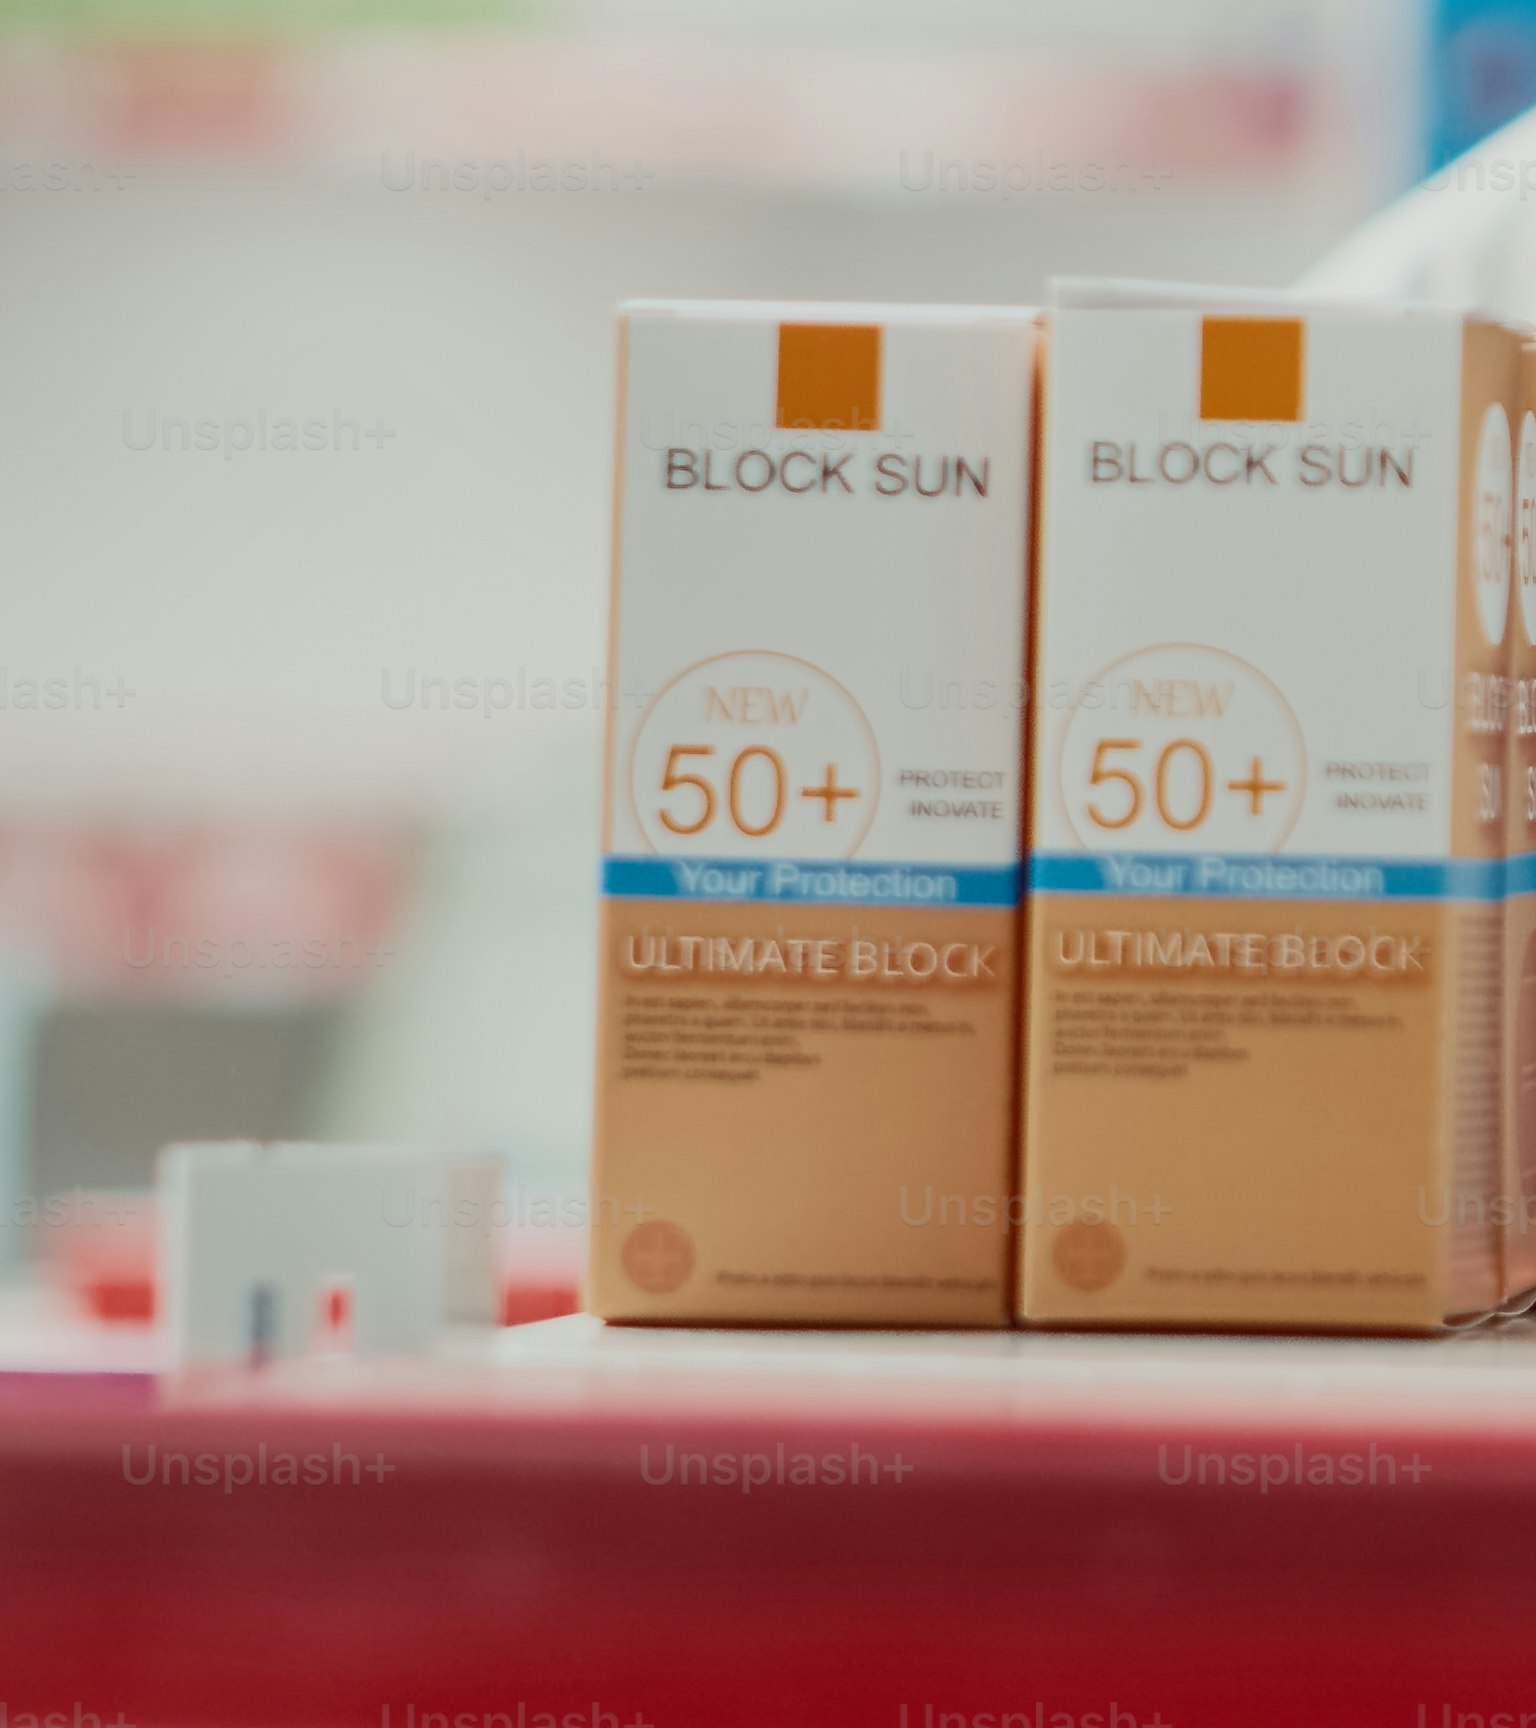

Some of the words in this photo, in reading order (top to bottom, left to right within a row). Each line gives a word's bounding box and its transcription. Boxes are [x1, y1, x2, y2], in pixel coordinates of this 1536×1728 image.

[665, 448, 854, 494] BLOCK
[874, 453, 990, 497] SUN
[1091, 441, 1278, 485] BLOCK
[1299, 444, 1414, 488] SUN
[704, 685, 810, 725] NEW
[1132, 678, 1236, 719] NEW
[896, 768, 1005, 790] PROTECT
[1087, 738, 1287, 832] 50+
[1321, 759, 1432, 781] PROTECT
[658, 744, 860, 838] 50+
[910, 799, 1005, 820] INOVATE
[1335, 791, 1429, 812] INOVATE
[674, 859, 764, 898] Your
[772, 862, 957, 900] Protection
[1106, 854, 1184, 891] Your
[1199, 855, 1385, 893] Protection
[628, 935, 838, 974] ULTIMATE
[855, 941, 995, 978] BLOCK
[1058, 929, 1267, 967] ULTIMATE
[1283, 934, 1424, 971] BLOCK
